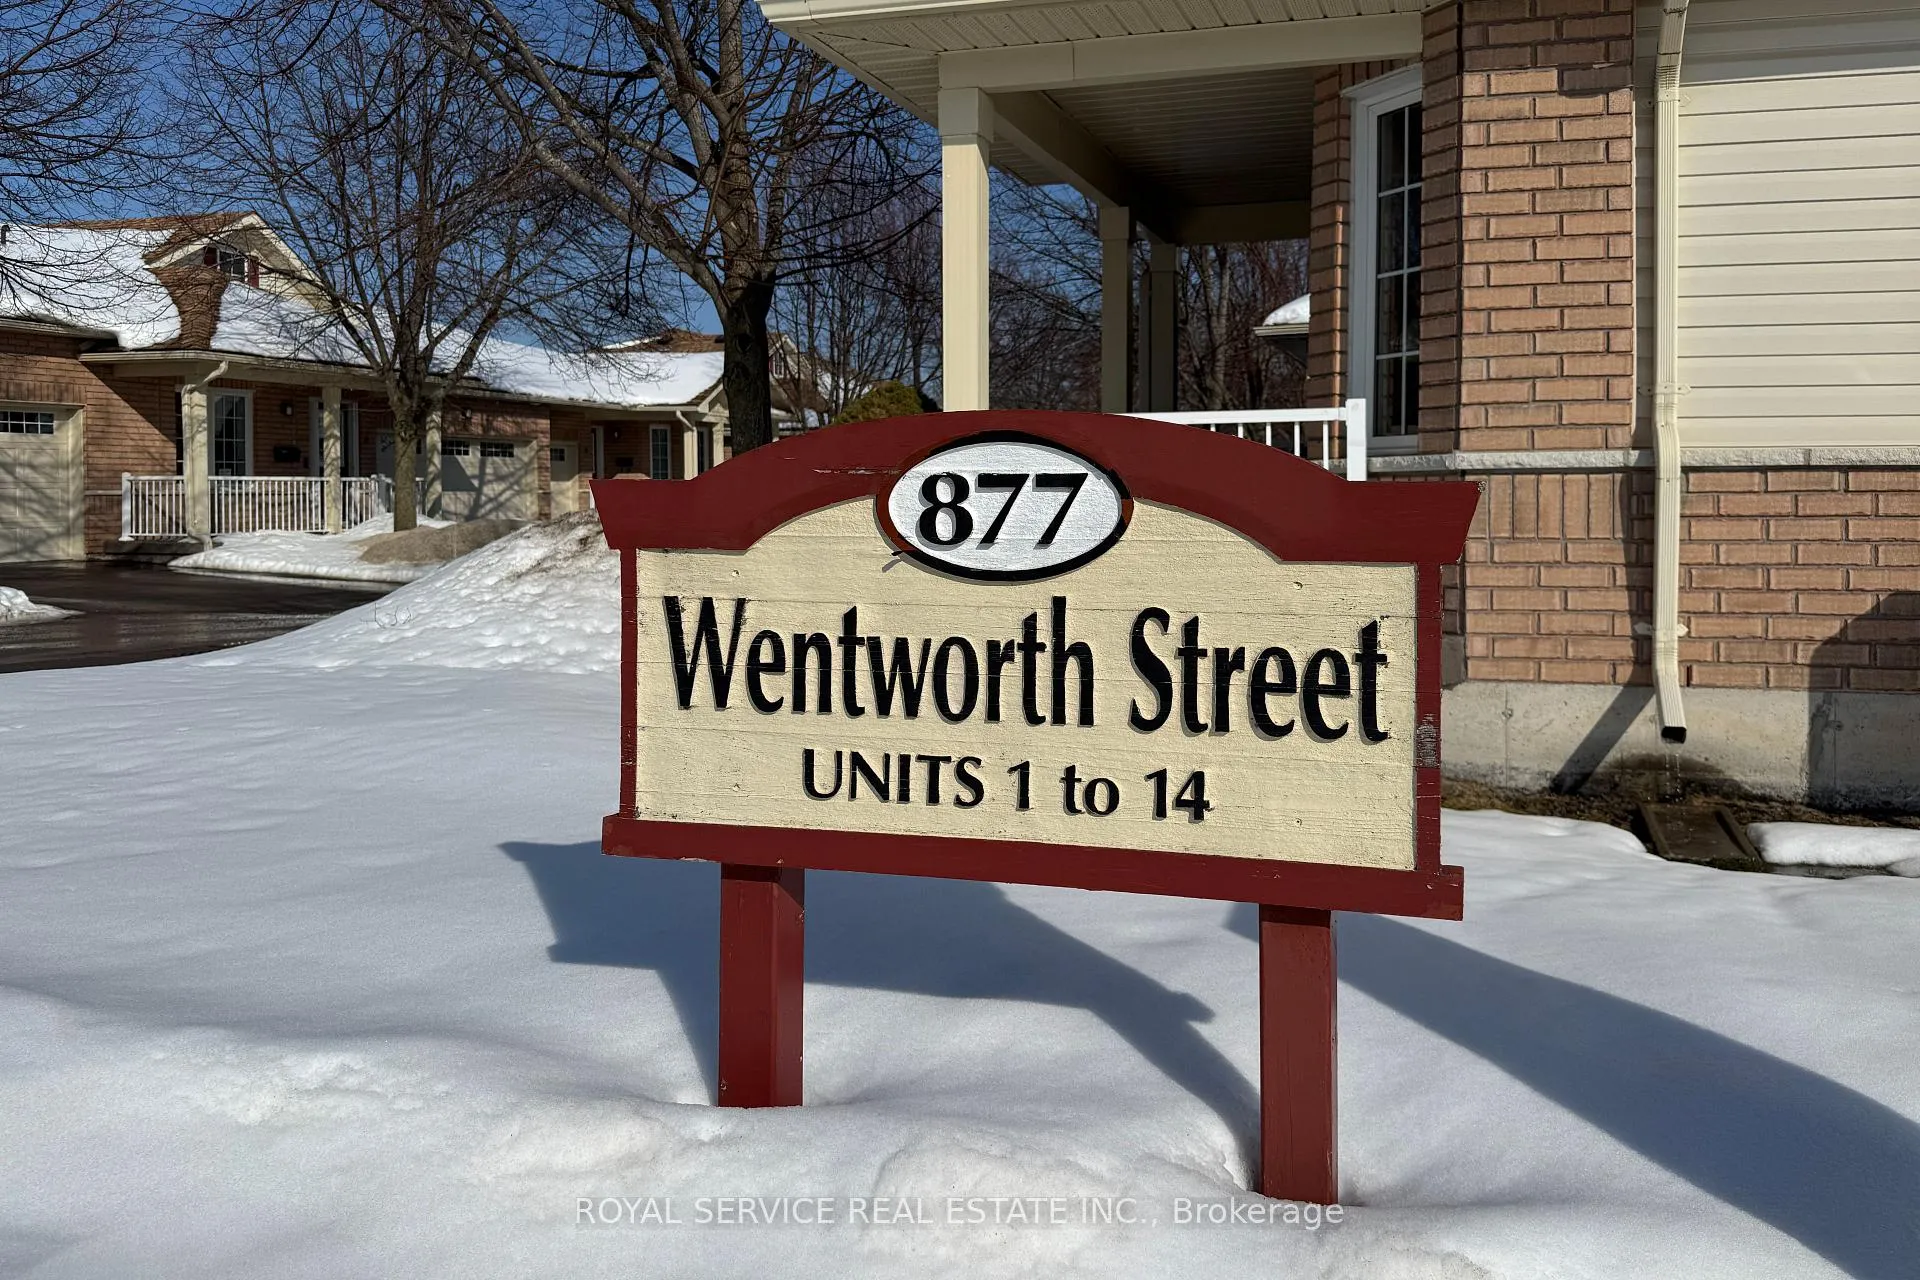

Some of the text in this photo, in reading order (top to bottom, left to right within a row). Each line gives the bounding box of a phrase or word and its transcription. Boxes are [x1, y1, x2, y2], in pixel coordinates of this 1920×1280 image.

[917, 471, 1089, 548] 877
[663, 595, 1389, 742] Wentworth Street
[803, 747, 1211, 823] UNITS 1 to 14
